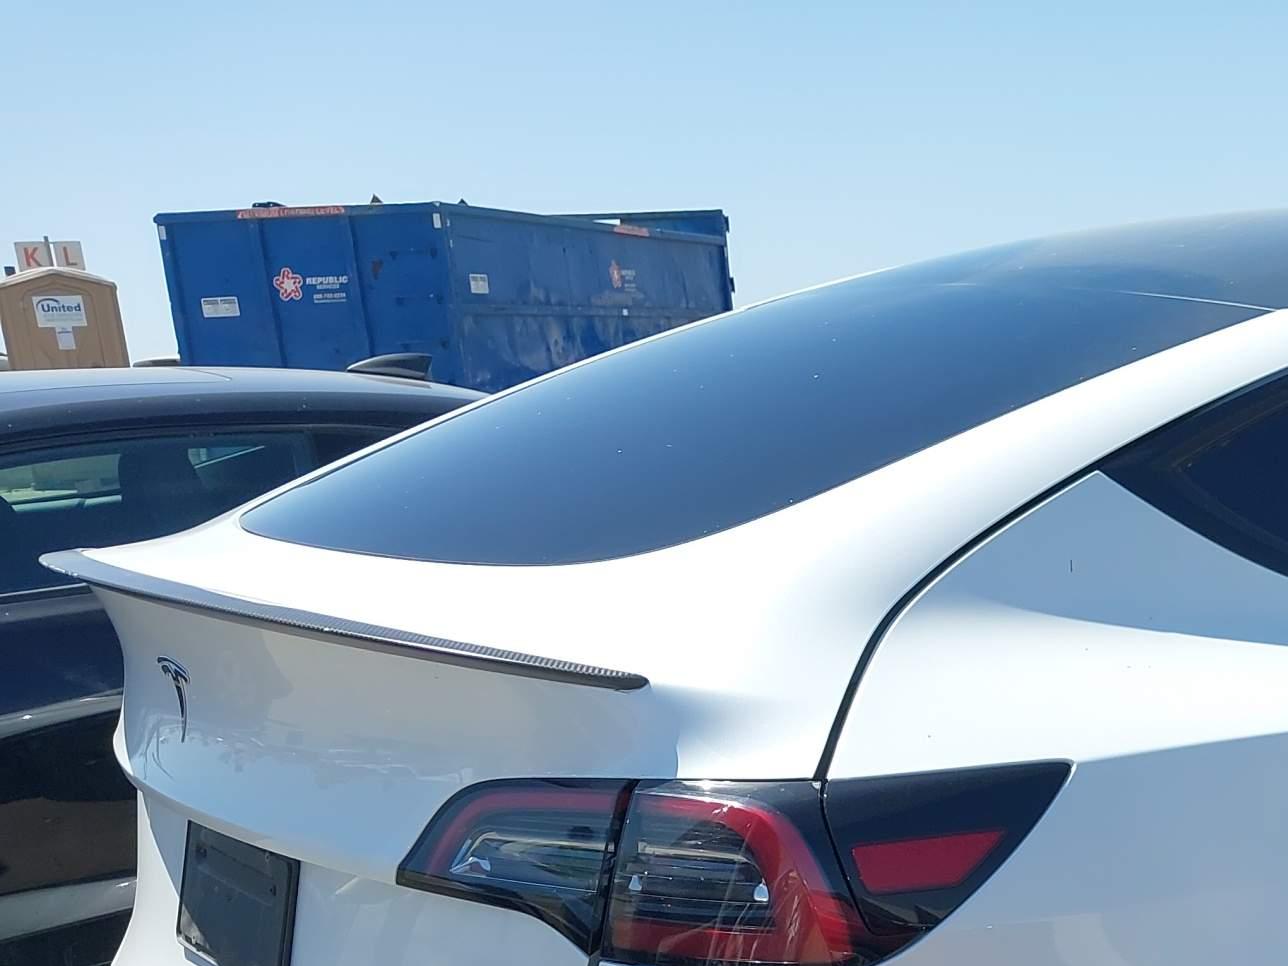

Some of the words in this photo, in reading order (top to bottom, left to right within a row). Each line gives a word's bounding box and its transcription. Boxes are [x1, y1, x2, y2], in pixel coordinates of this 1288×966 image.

[23, 247, 42, 267] K
[62, 246, 78, 266] L
[305, 276, 348, 284] REPUBLIC
[41, 303, 81, 312] United
